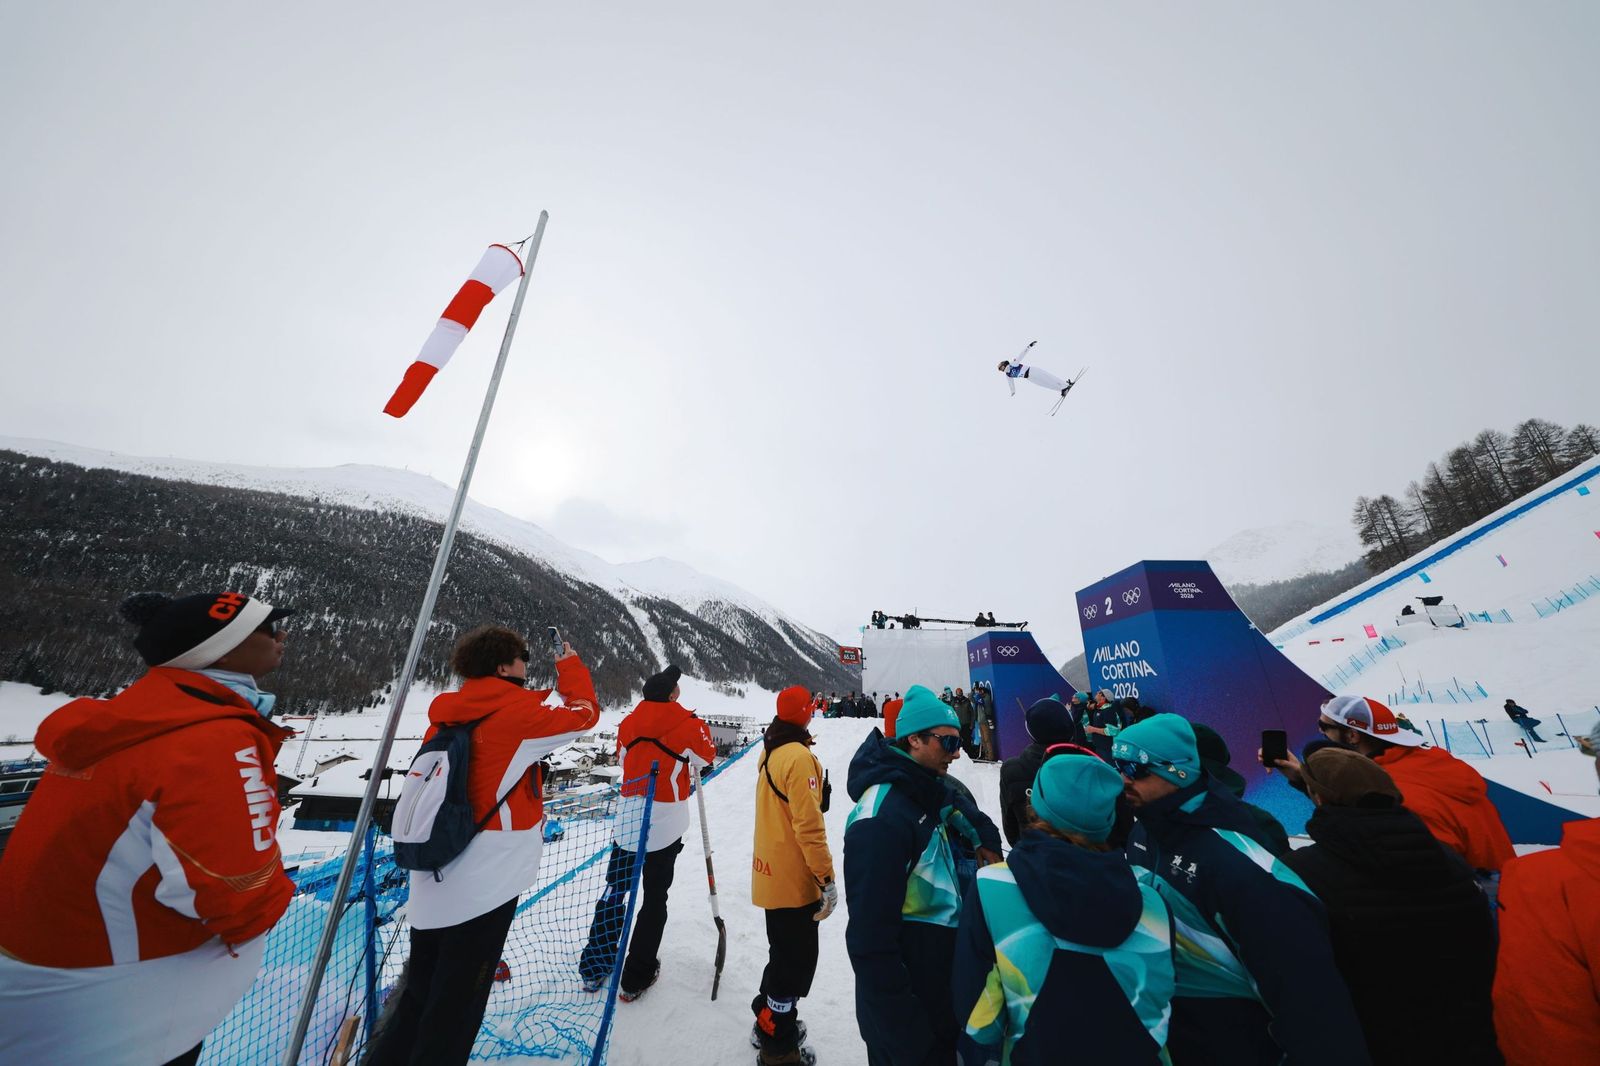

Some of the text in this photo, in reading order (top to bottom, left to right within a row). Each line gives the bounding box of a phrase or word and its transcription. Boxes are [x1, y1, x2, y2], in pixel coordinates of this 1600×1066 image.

[1104, 597, 1113, 616] 2
[1092, 640, 1140, 663] MILANO
[1101, 660, 1158, 680] CORTINA
[1112, 682, 1139, 699] 2026
[234, 746, 275, 852] CHINA
